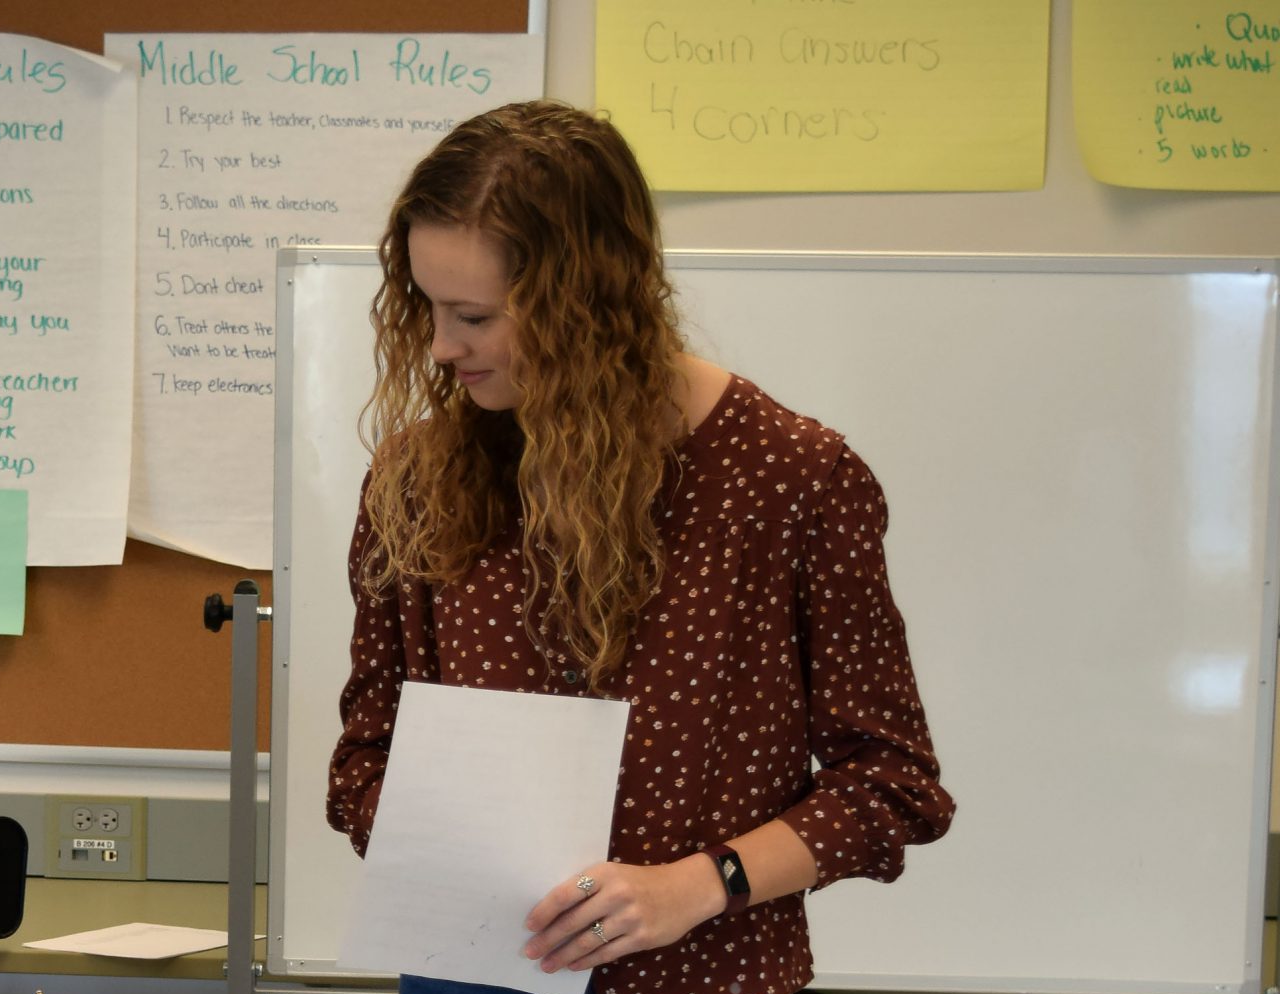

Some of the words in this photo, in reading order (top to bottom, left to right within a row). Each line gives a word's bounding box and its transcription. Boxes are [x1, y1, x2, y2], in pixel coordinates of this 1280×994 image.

[644, 21, 753, 64] Chain
[138, 41, 242, 86] Middle
[266, 45, 359, 86] School
[389, 38, 492, 95] Rules
[1173, 45, 1219, 69] write
[1156, 76, 1192, 94] read
[651, 82, 677, 130] 4
[1155, 102, 1222, 134] picture
[180, 106, 234, 131] Respect
[242, 110, 262, 127] the
[269, 109, 316, 130] teacher,
[384, 118, 403, 129] and
[159, 150, 175, 169] 2.
[180, 148, 204, 172] Try
[214, 152, 242, 170] your
[251, 150, 281, 168] best
[1157, 138, 1172, 162] 5
[160, 194, 173, 211] 3.
[176, 192, 218, 210] Follow
[229, 195, 245, 209] all
[252, 195, 271, 210] the
[276, 195, 339, 213] directions
[158, 228, 175, 250] 4.
[181, 229, 252, 253] Participate
[266, 237, 279, 247] in
[155, 272, 174, 297] 5.
[225, 277, 264, 294] cheat
[31, 315, 69, 338] you
[155, 315, 171, 336] 6.
[176, 316, 208, 334] Treat
[214, 320, 249, 334] others
[255, 320, 272, 335] the
[207, 345, 220, 356] to
[224, 345, 238, 357] be
[152, 373, 168, 394] 7.
